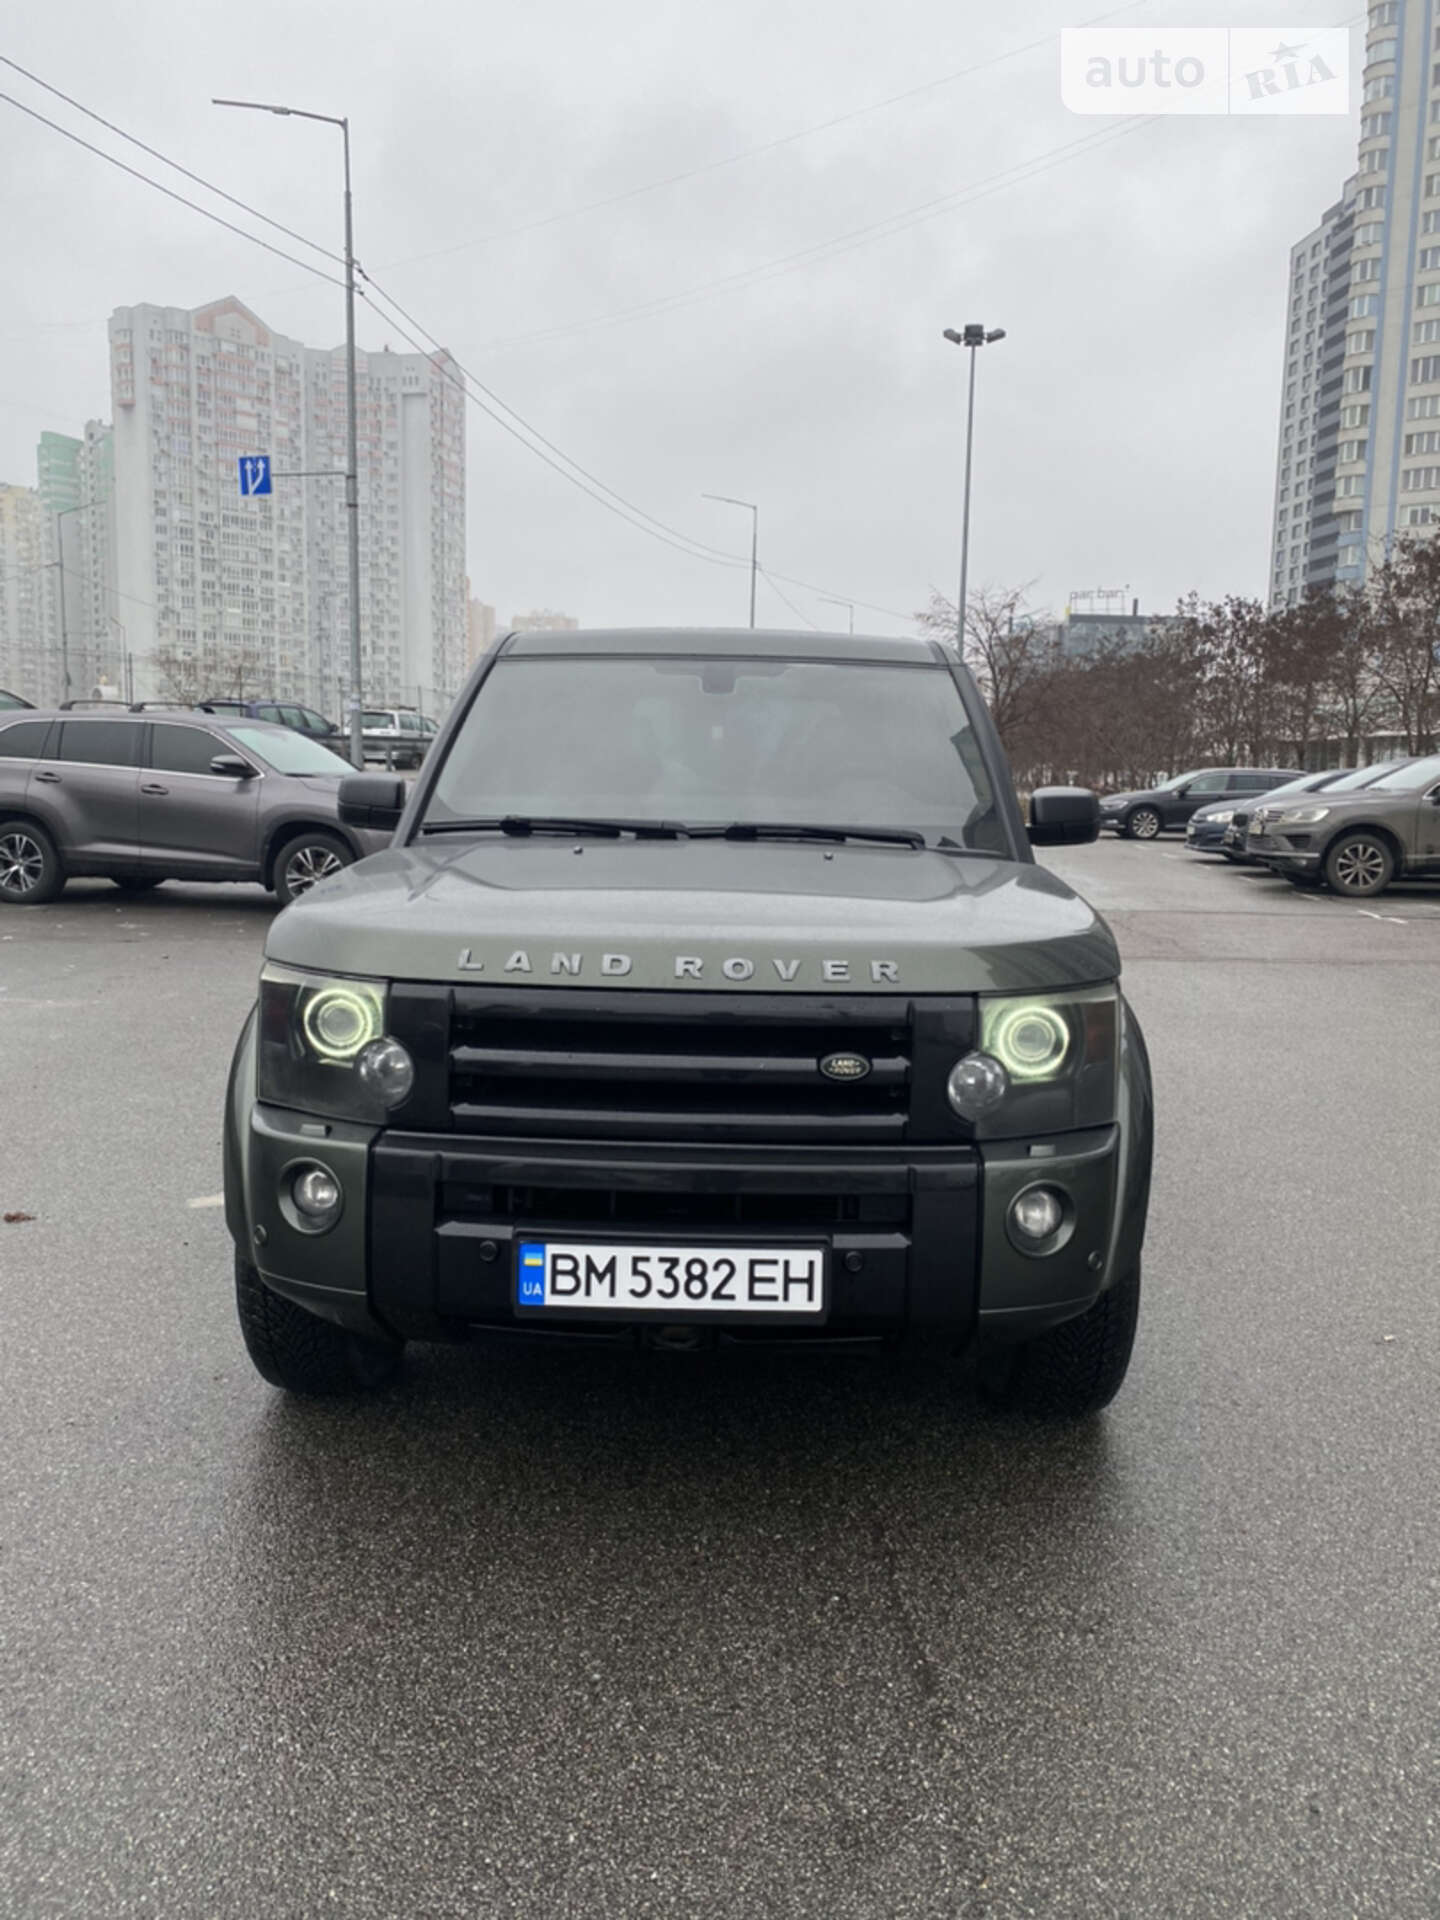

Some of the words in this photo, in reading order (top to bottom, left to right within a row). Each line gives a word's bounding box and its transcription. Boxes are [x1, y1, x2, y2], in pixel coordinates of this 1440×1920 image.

[457, 947, 633, 977] LAND
[674, 955, 901, 983] ROVER
[522, 1281, 543, 1296] UA
[550, 1253, 617, 1298] BM
[628, 1256, 737, 1300] 5382
[748, 1259, 816, 1303] EH
